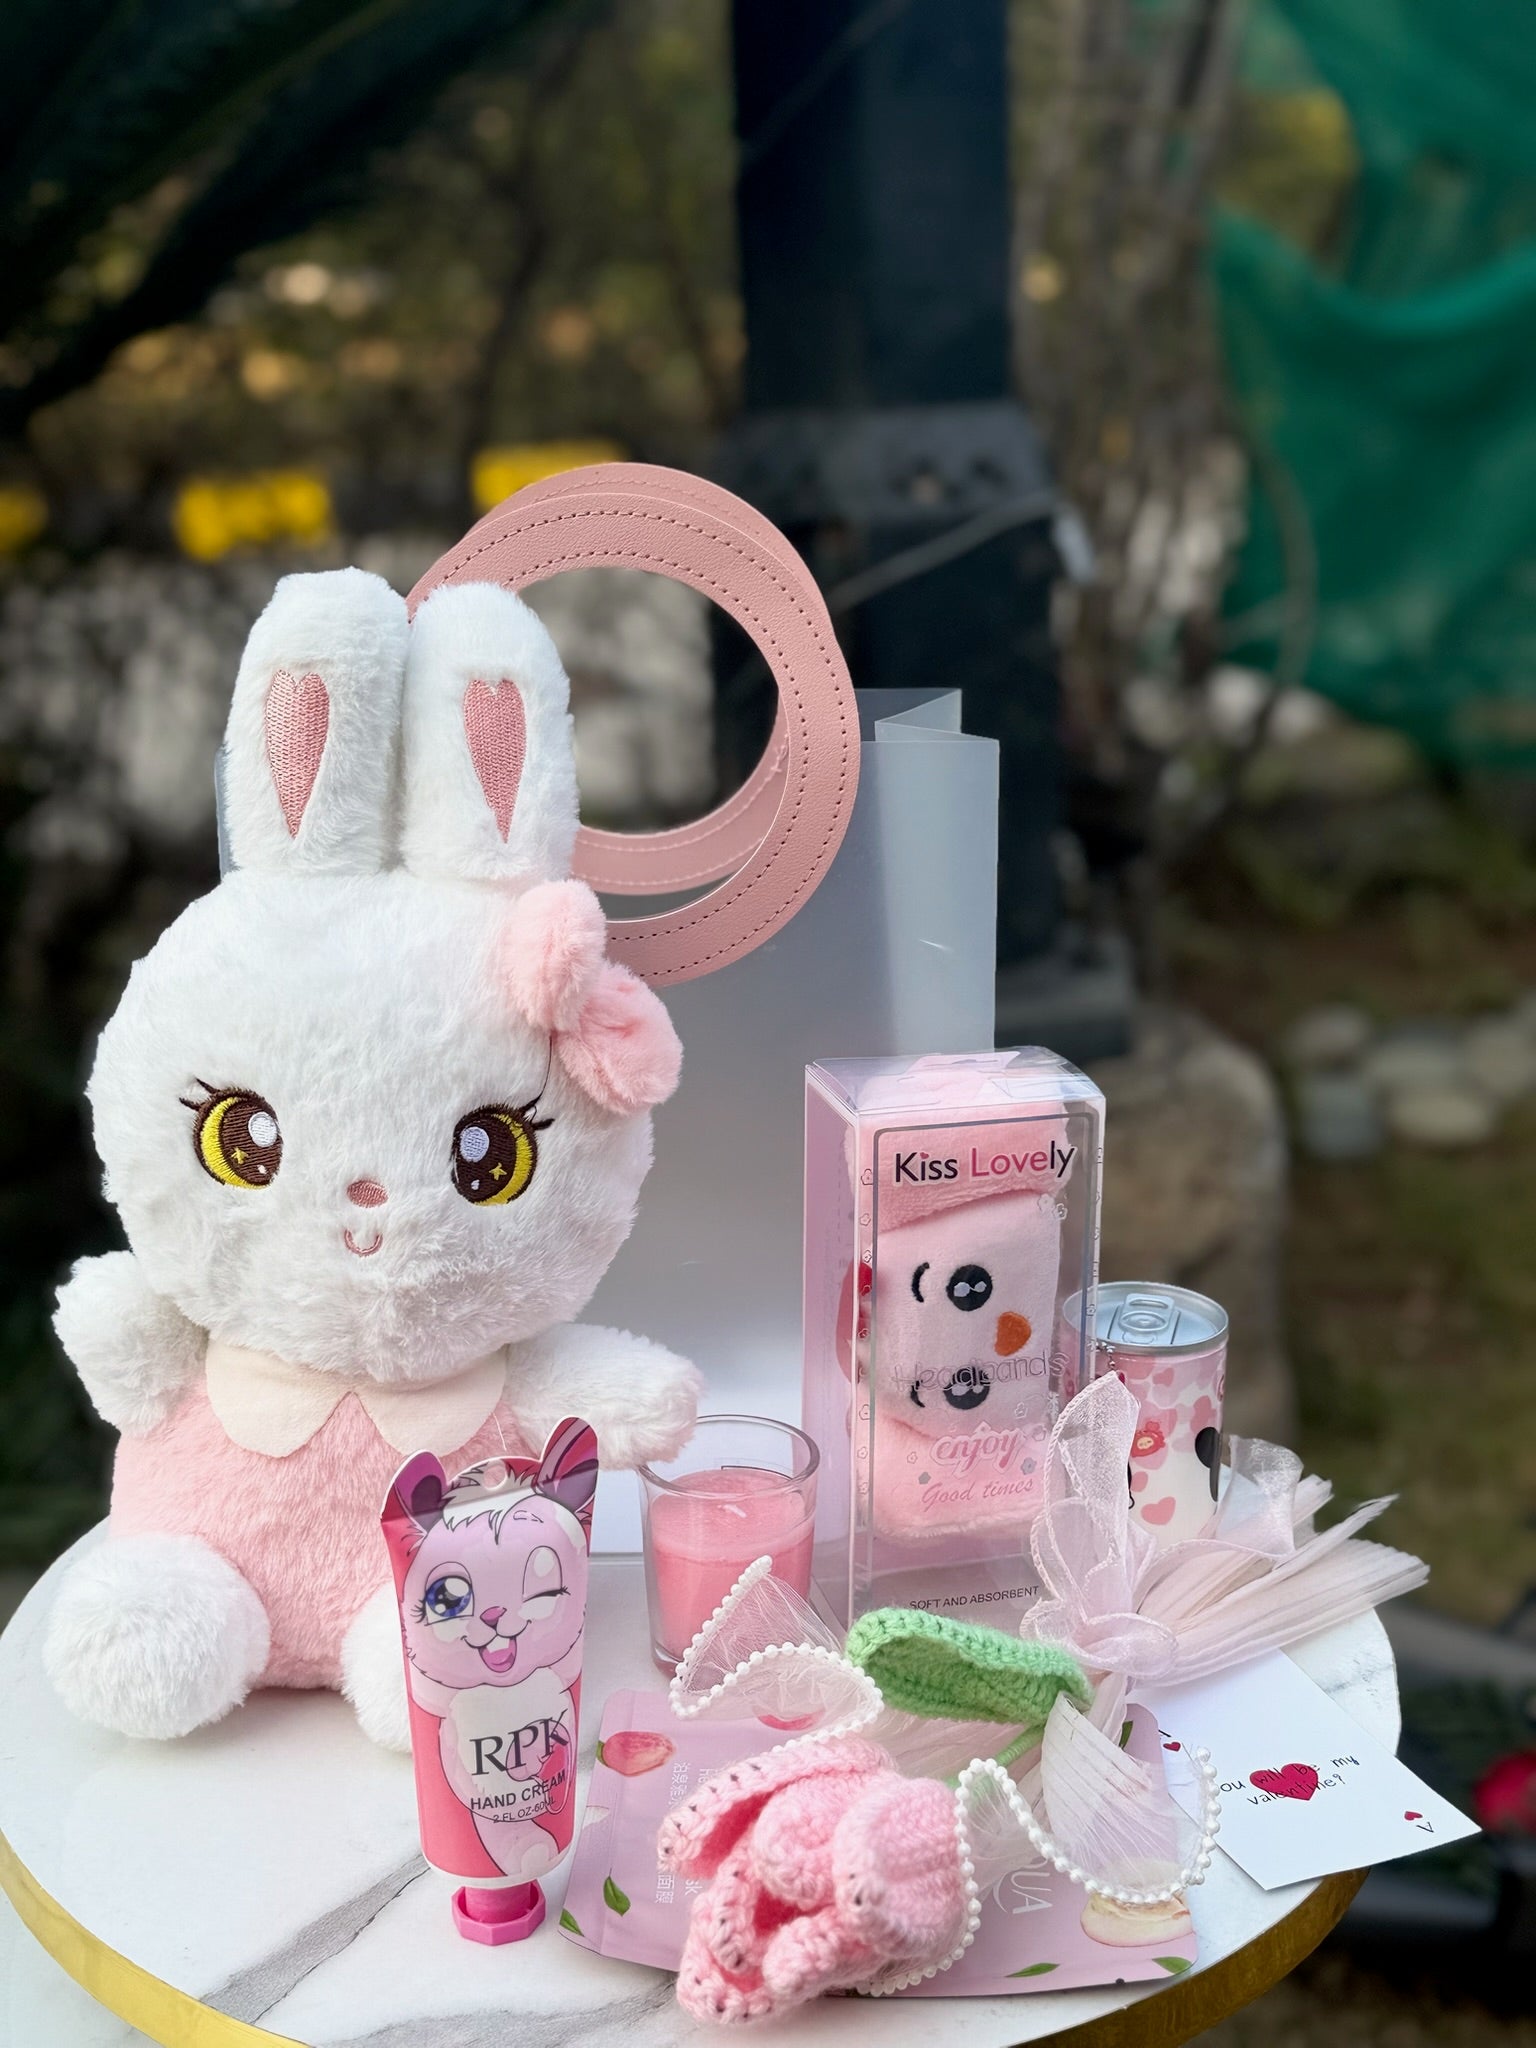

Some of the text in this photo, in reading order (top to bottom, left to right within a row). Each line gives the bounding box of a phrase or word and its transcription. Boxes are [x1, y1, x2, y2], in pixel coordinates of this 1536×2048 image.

[895, 1140, 1075, 1183] Kiss Lovely
[892, 1351, 1069, 1391] Headbands
[935, 1425, 1020, 1474] enjoy
[922, 1478, 1034, 1512] Good times
[909, 1585, 1039, 1611] SOFT AND ABSORBENT
[469, 1708, 569, 1776] RPK
[470, 1769, 566, 1811] HAND CREAM
[1219, 1754, 1361, 1793] ou will be my
[1246, 1772, 1347, 1806] valentine?
[493, 1814, 500, 1824] 2
[502, 1812, 516, 1822] FL
